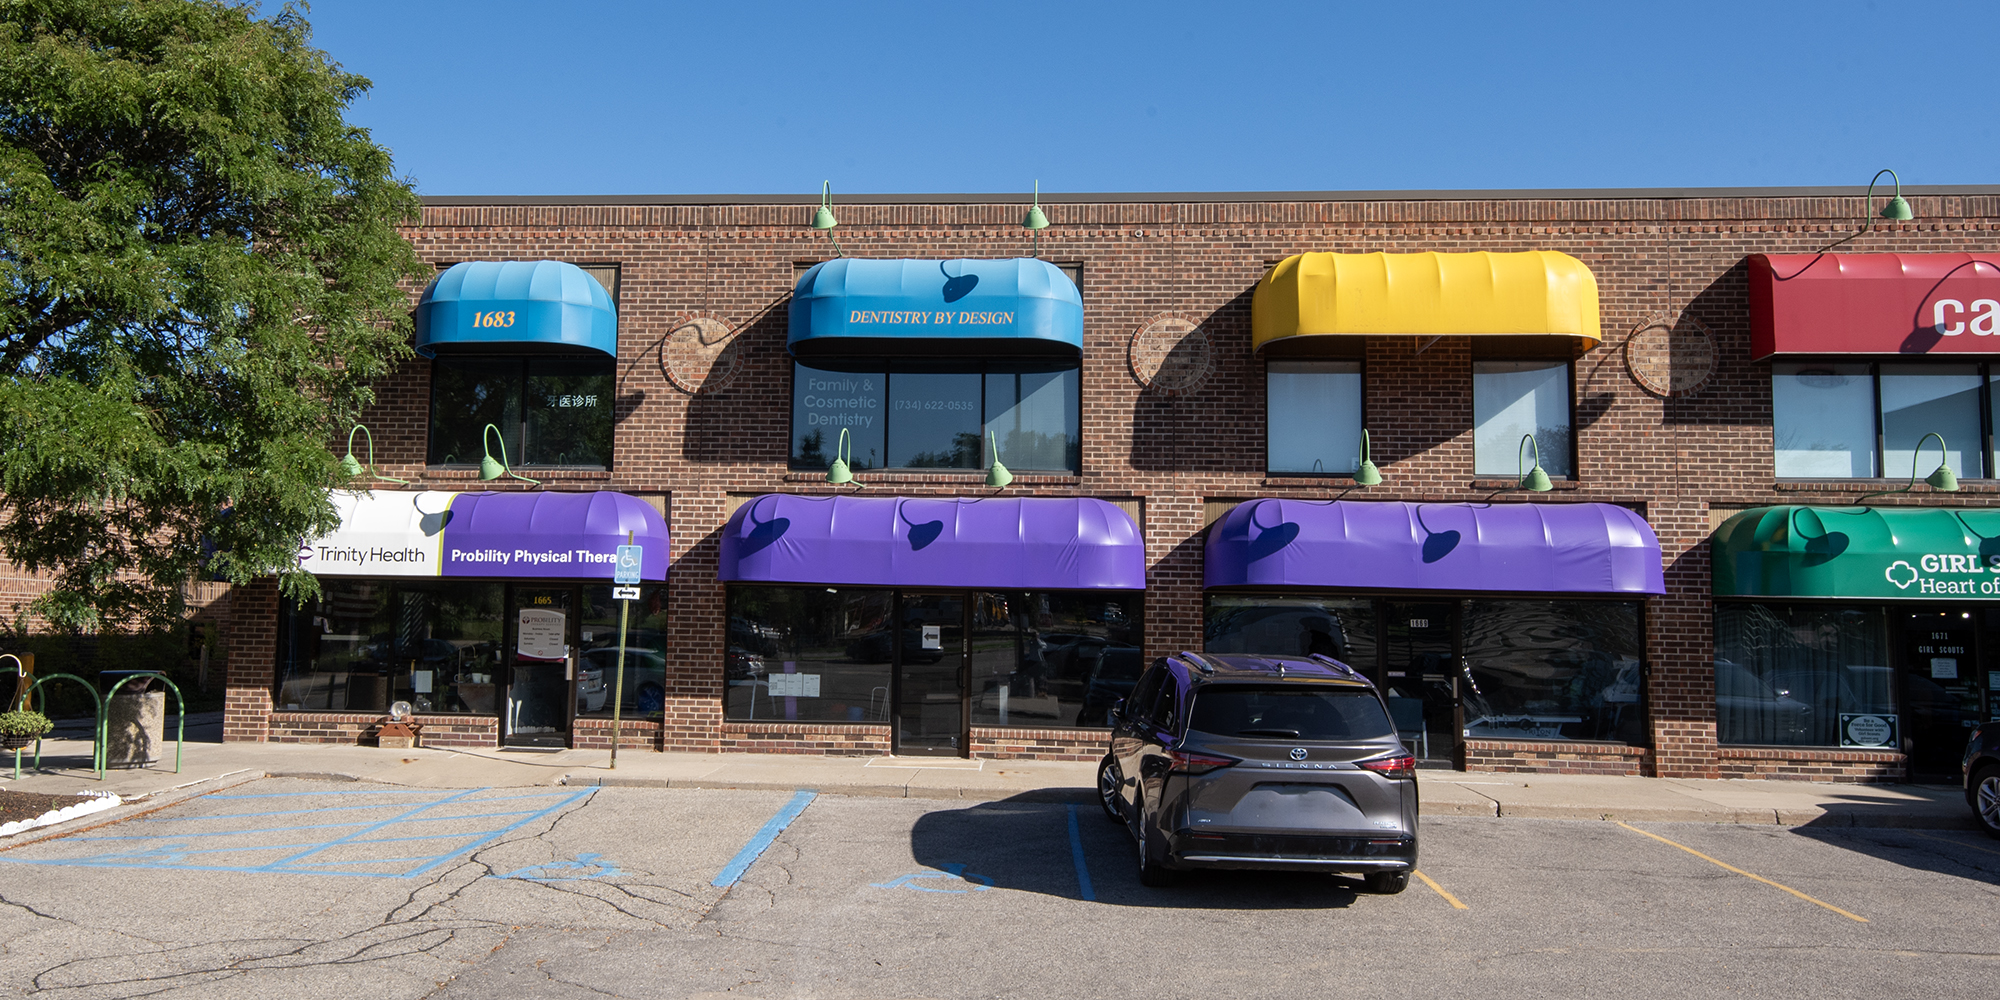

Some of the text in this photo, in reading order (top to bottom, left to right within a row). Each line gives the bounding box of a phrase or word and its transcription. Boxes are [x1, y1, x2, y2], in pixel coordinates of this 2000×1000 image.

[472, 310, 516, 328] 1683
[850, 310, 1014, 325] DENTISTRY BY DESIGN
[1933, 298, 2000, 336] ca
[808, 378, 874, 394] Family &
[546, 394, 598, 408] 牙医诊所
[804, 395, 877, 409] Cosmetic
[895, 399, 974, 411] (734) 622-0535
[808, 412, 873, 429] Dentistry
[318, 546, 425, 566] Trinity Health
[451, 549, 617, 565] Probility Physical Thera
[1920, 554, 1984, 573] GIRL
[616, 570, 639, 579] PARKING
[1919, 577, 2000, 594] Heart of
[534, 596, 552, 604] 1665
[1411, 619, 1428, 627] 1669
[1931, 632, 1948, 640] 1671
[1918, 645, 1965, 654] GIRL SCOUTS
